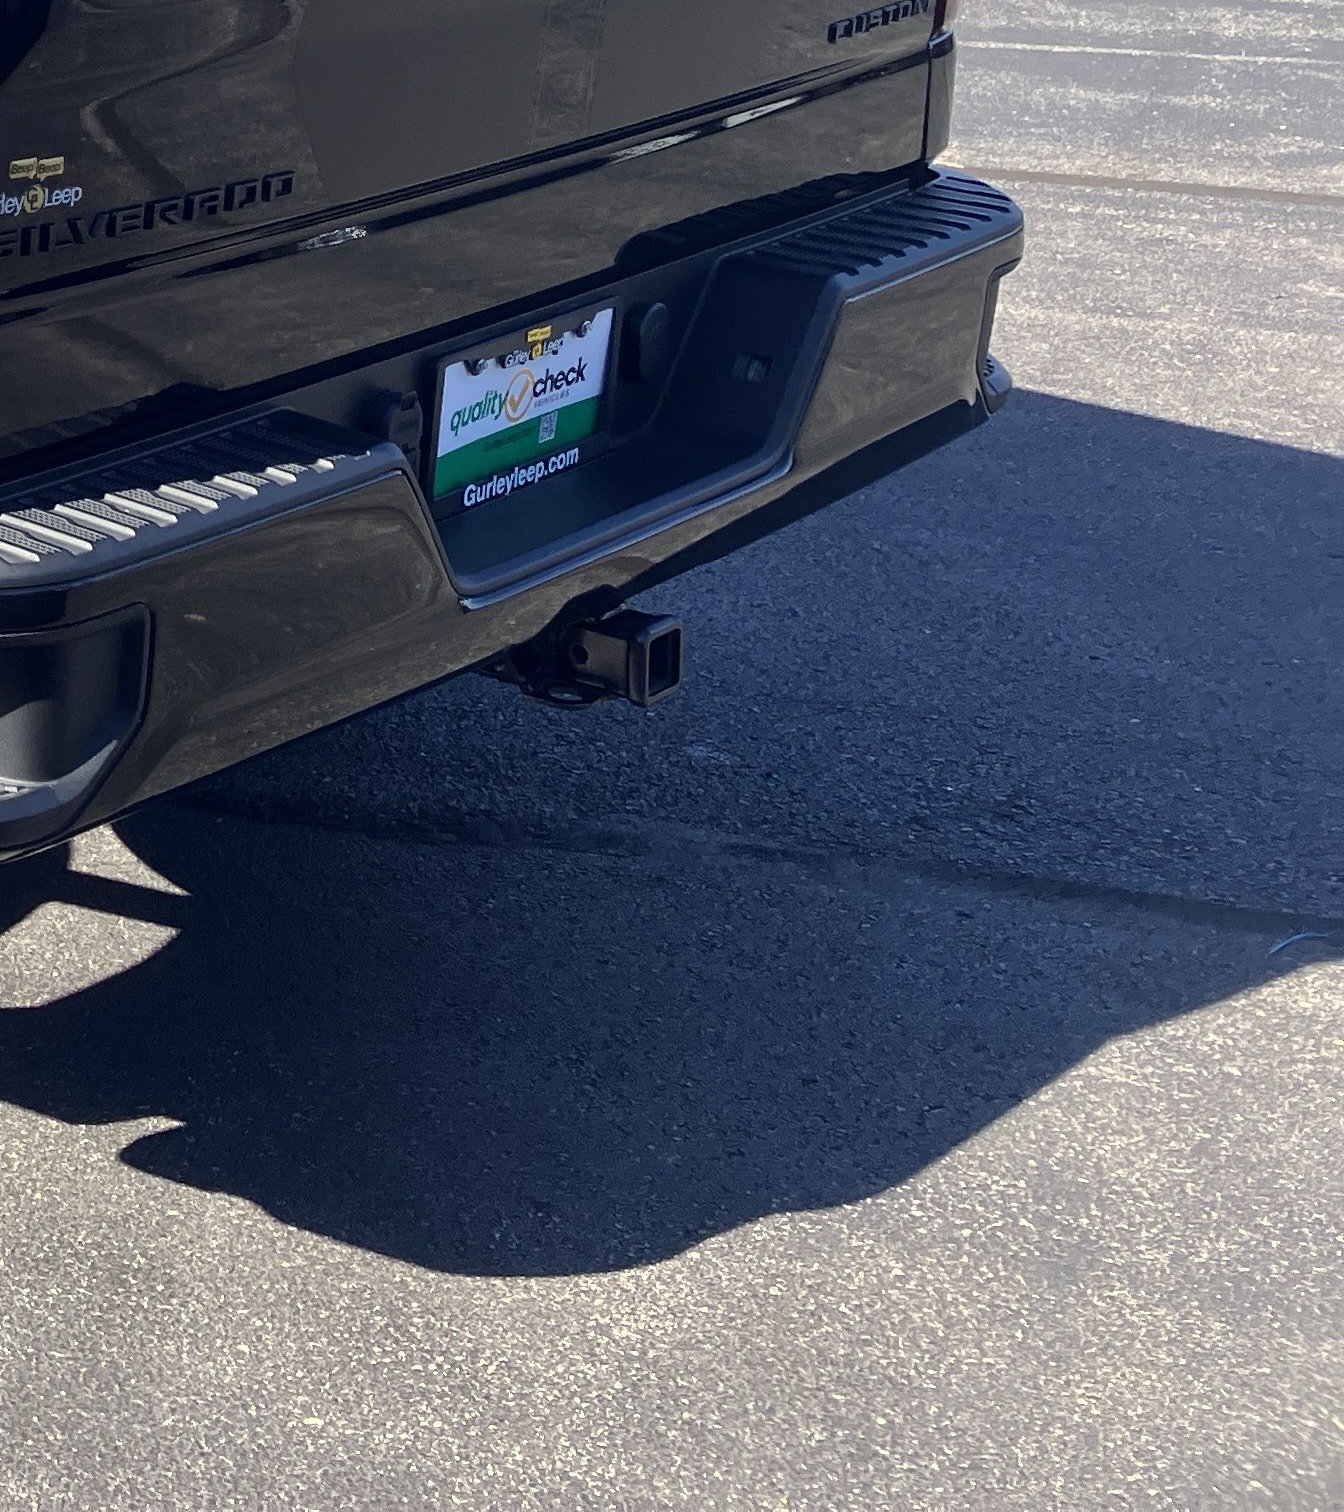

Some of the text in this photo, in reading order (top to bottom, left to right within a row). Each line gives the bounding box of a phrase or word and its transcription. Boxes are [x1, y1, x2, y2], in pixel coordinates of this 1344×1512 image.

[44, 186, 83, 208] Leep
[450, 356, 590, 436] quality check
[463, 446, 580, 507] Gurleyleep.com
